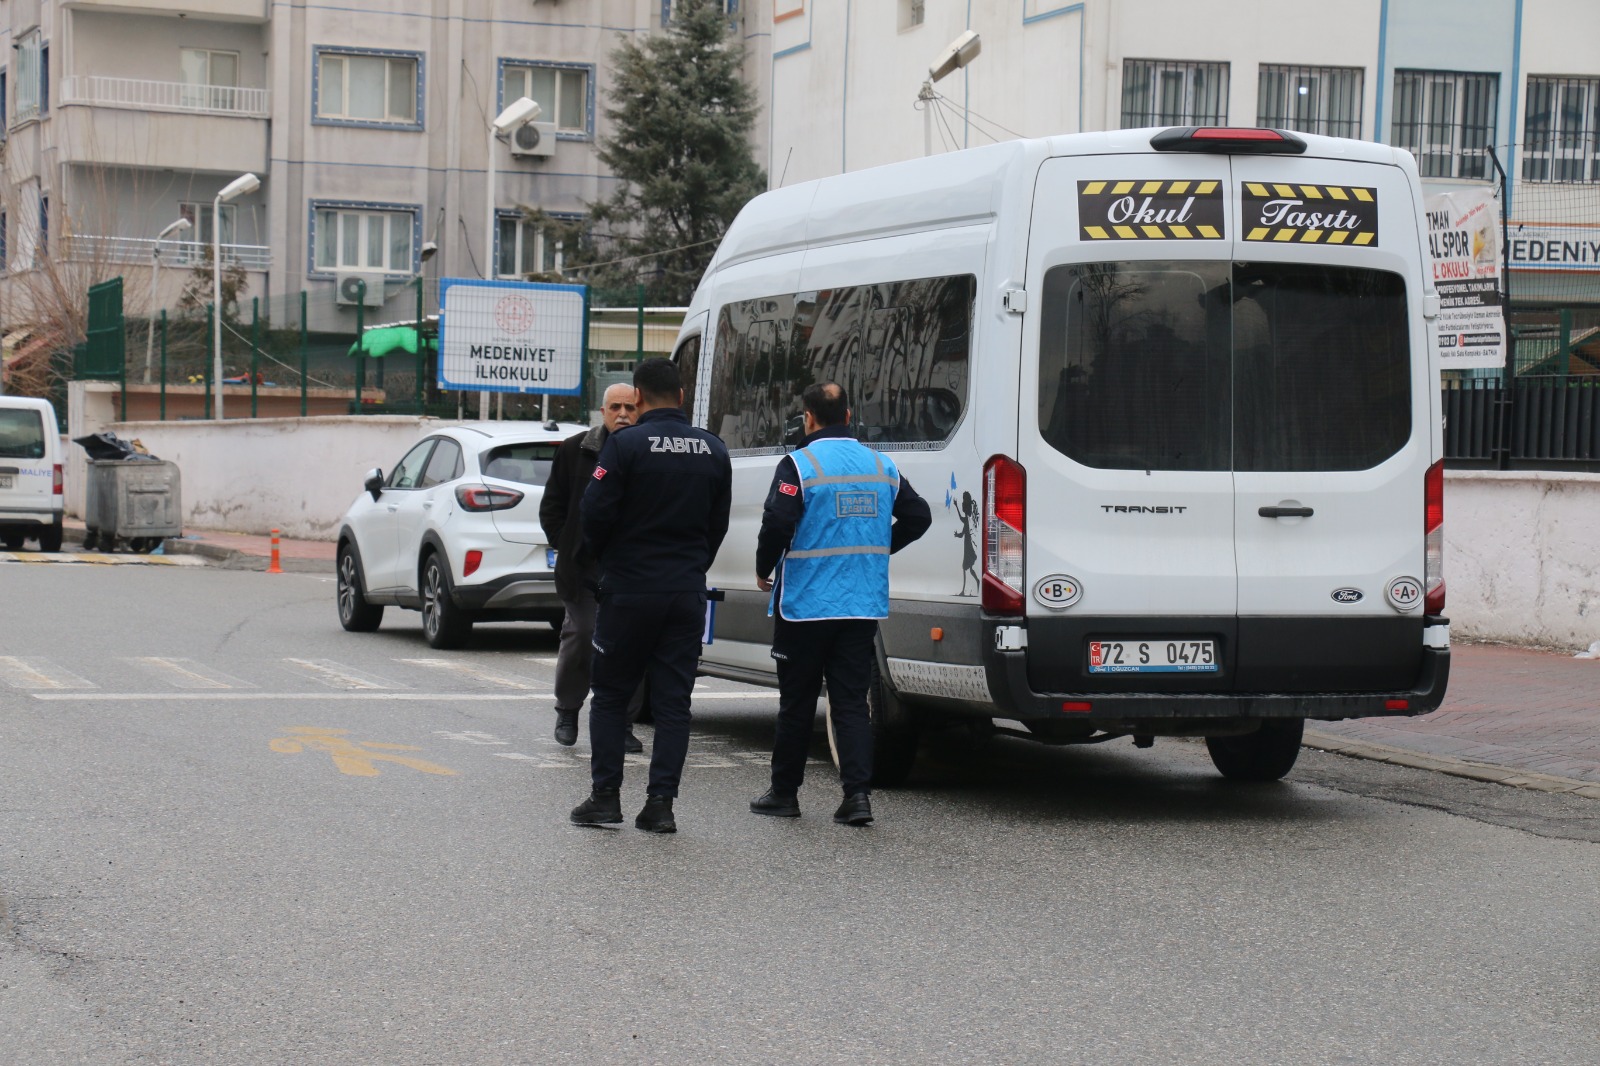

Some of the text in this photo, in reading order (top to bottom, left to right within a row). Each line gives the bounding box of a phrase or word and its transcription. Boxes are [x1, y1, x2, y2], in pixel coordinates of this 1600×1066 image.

[1107, 195, 1362, 230] Okul Taşıtı
[1442, 230, 1470, 258] SPOR
[1441, 260, 1470, 279] OKULU
[470, 344, 556, 363] MEDENİYET
[475, 361, 549, 382] İLKOKULU
[647, 436, 712, 455] ZABITA
[1100, 505, 1187, 514] TRANSIT
[1052, 583, 1063, 598] B
[1338, 590, 1358, 601] Ford
[1400, 585, 1410, 600] A
[1092, 655, 1101, 664] TR
[1101, 642, 1213, 664] 72 S 0475
